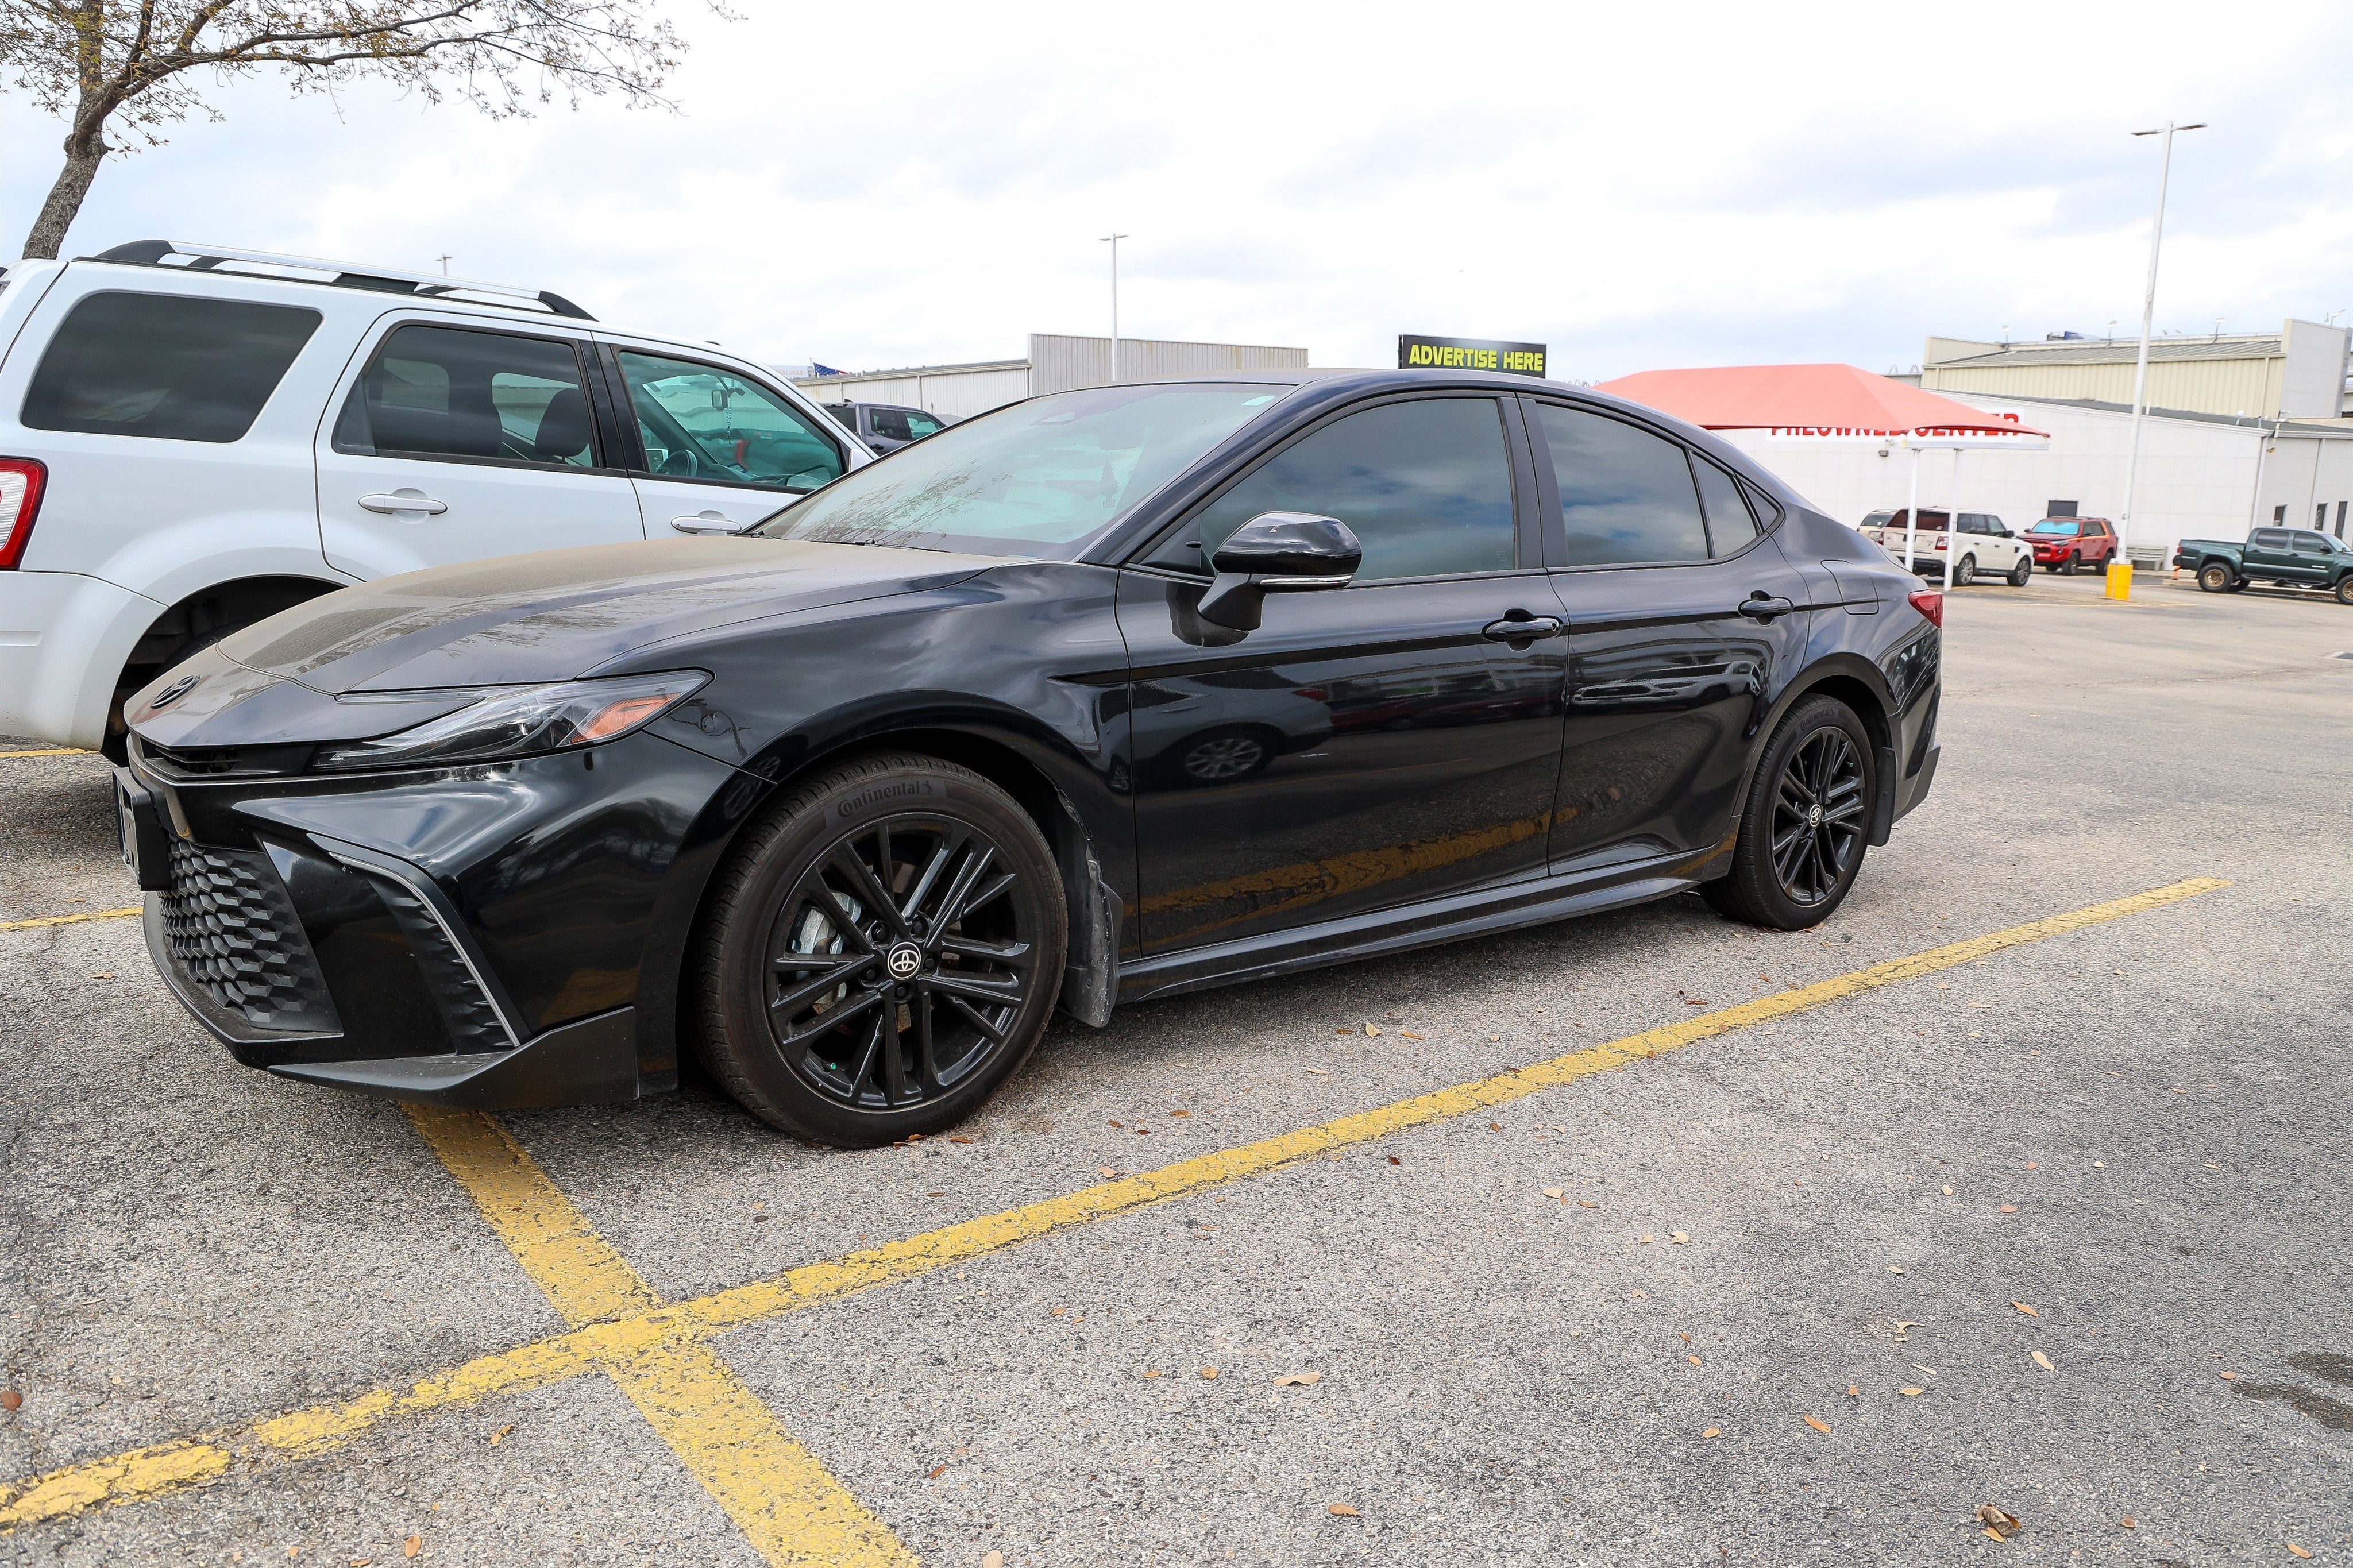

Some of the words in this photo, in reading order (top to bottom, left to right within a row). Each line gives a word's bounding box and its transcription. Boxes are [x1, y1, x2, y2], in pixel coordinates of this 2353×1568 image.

[1409, 345, 1497, 368] ADVERTISE
[1503, 350, 1544, 372] HERE
[1801, 707, 1830, 730] Continental
[837, 781, 920, 818] Continental
